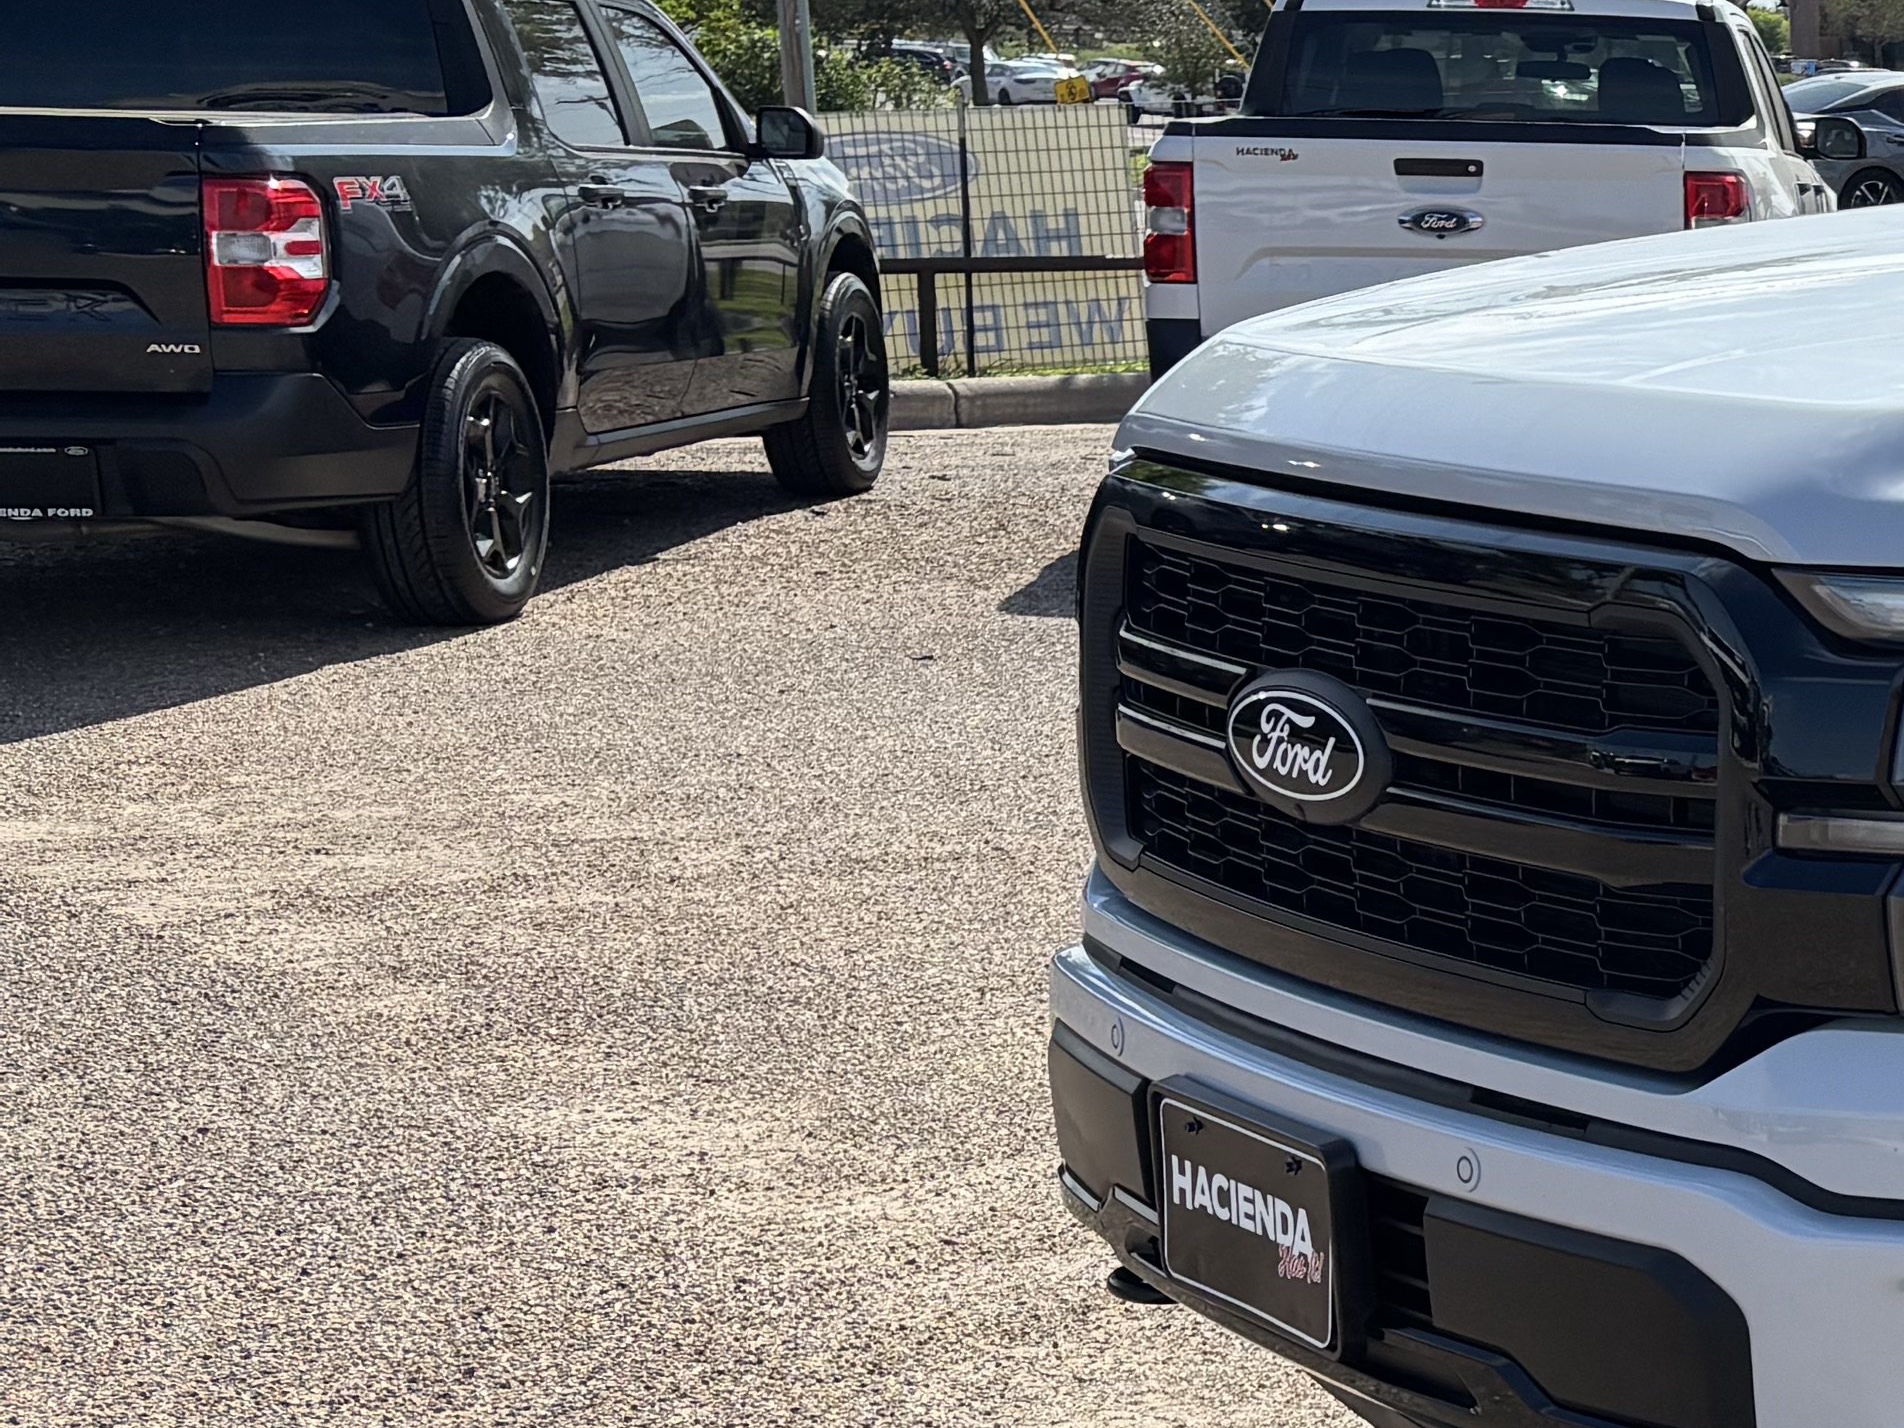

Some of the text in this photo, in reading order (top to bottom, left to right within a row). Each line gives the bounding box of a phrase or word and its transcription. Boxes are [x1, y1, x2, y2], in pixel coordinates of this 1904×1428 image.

[333, 175, 410, 210] FX4
[1420, 213, 1458, 229] Ford
[146, 344, 201, 354] AWD
[47, 508, 94, 518] FORD
[1252, 702, 1336, 787] Ford
[1171, 1154, 1315, 1258] HACIENDA
